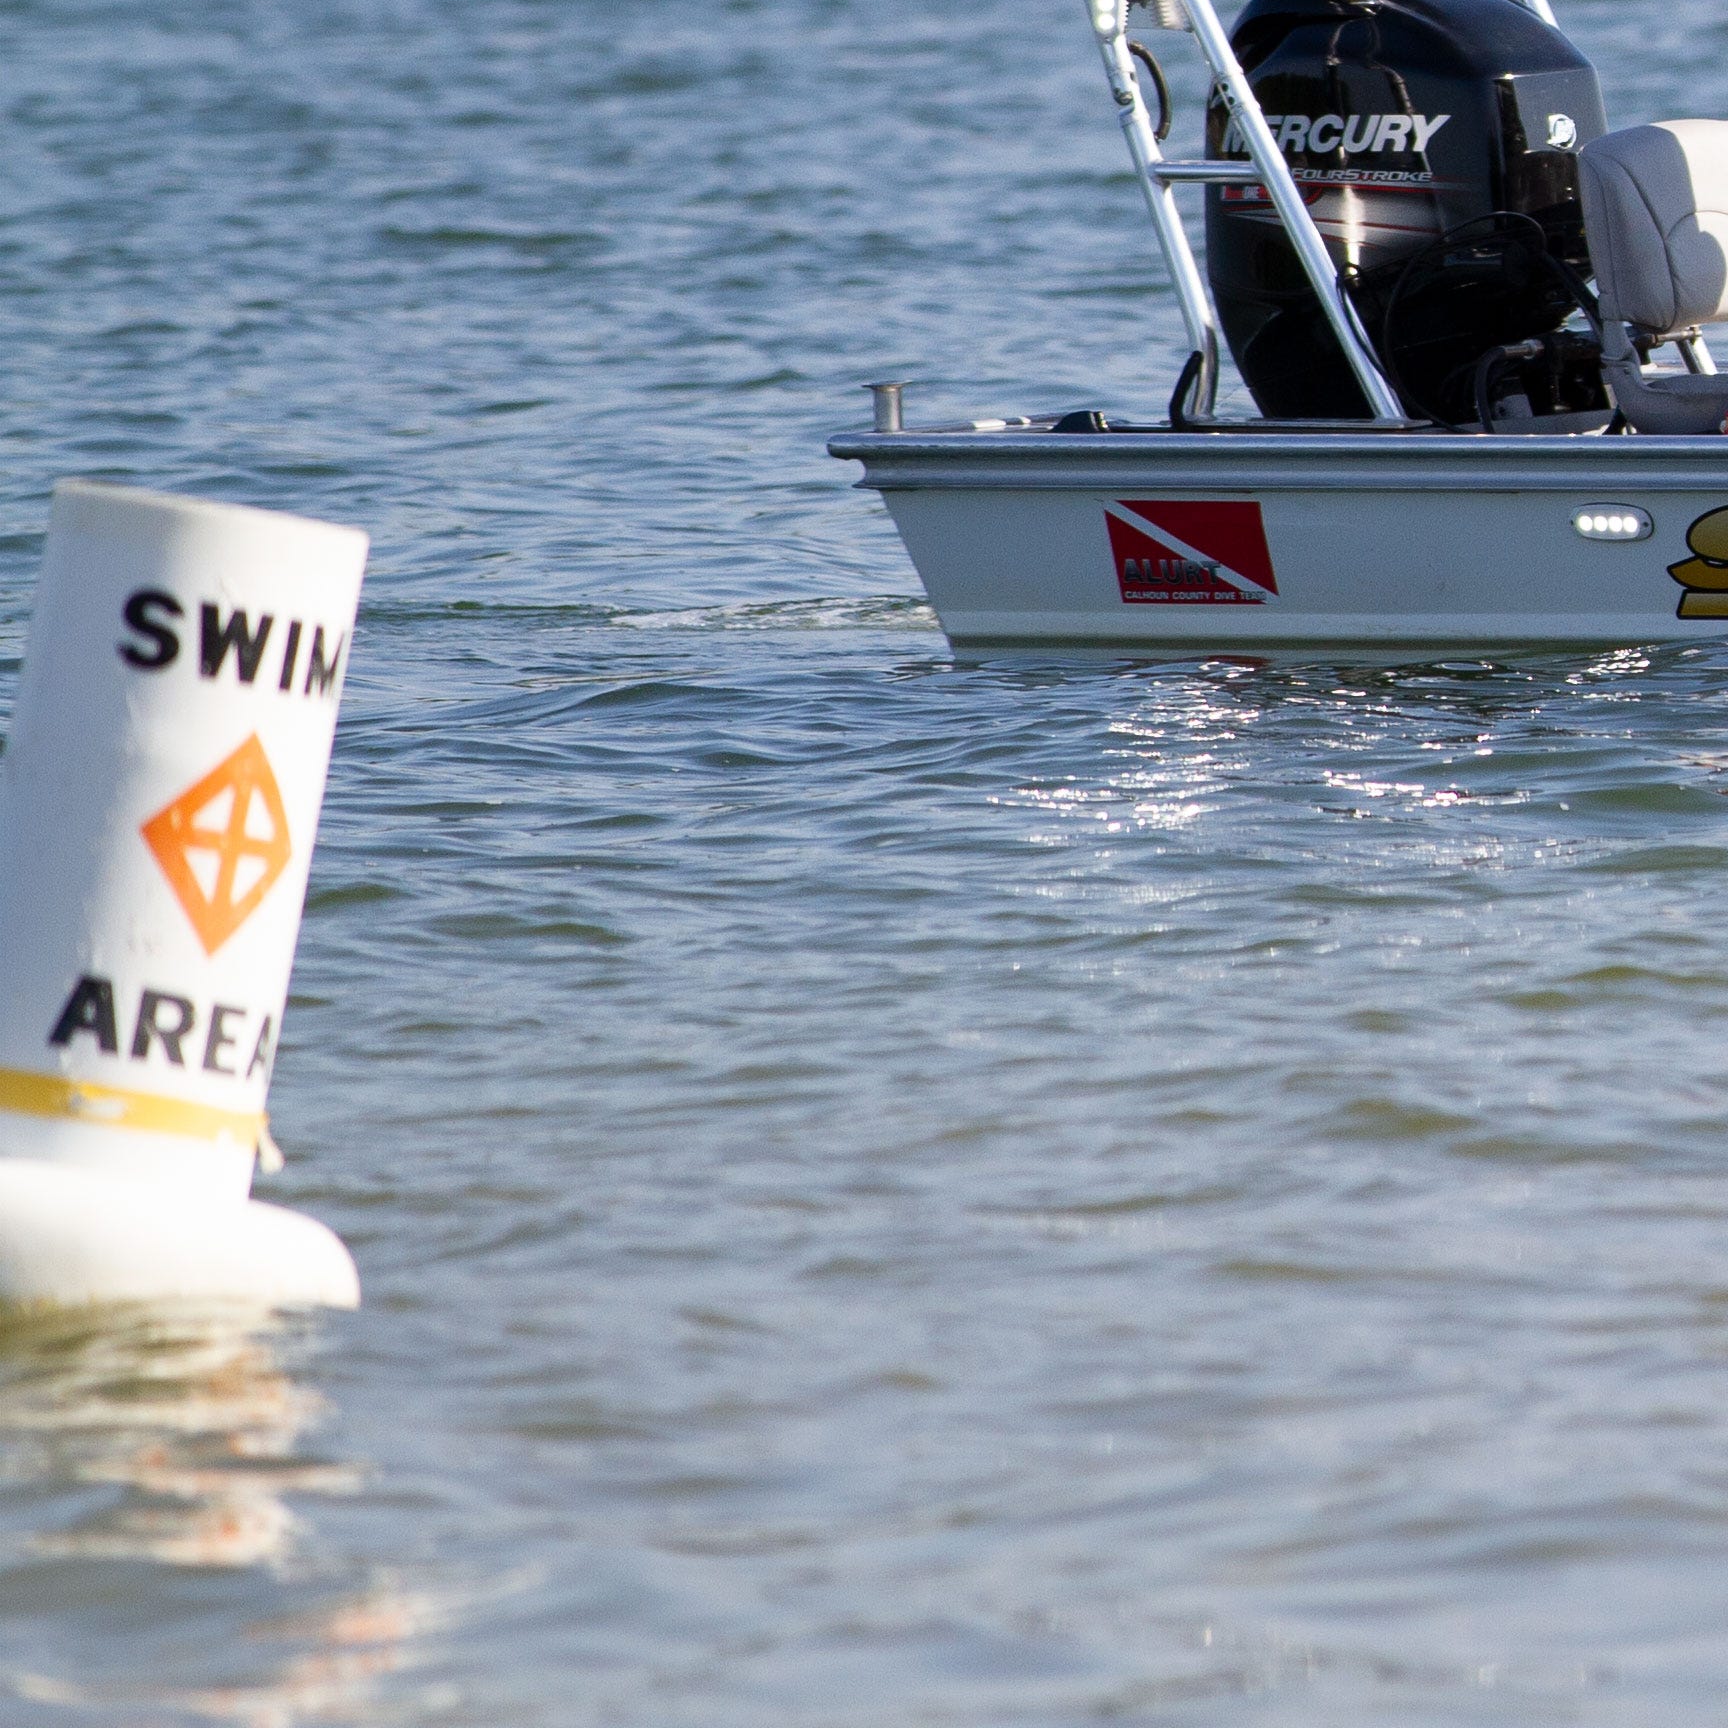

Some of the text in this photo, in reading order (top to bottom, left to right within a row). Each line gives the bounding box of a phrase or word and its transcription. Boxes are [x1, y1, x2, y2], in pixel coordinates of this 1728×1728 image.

[1124, 558, 1221, 584] ALURT
[1125, 591, 1169, 599] CALHOUN
[1172, 591, 1210, 600] COUNTY
[1214, 592, 1236, 600] DIVE
